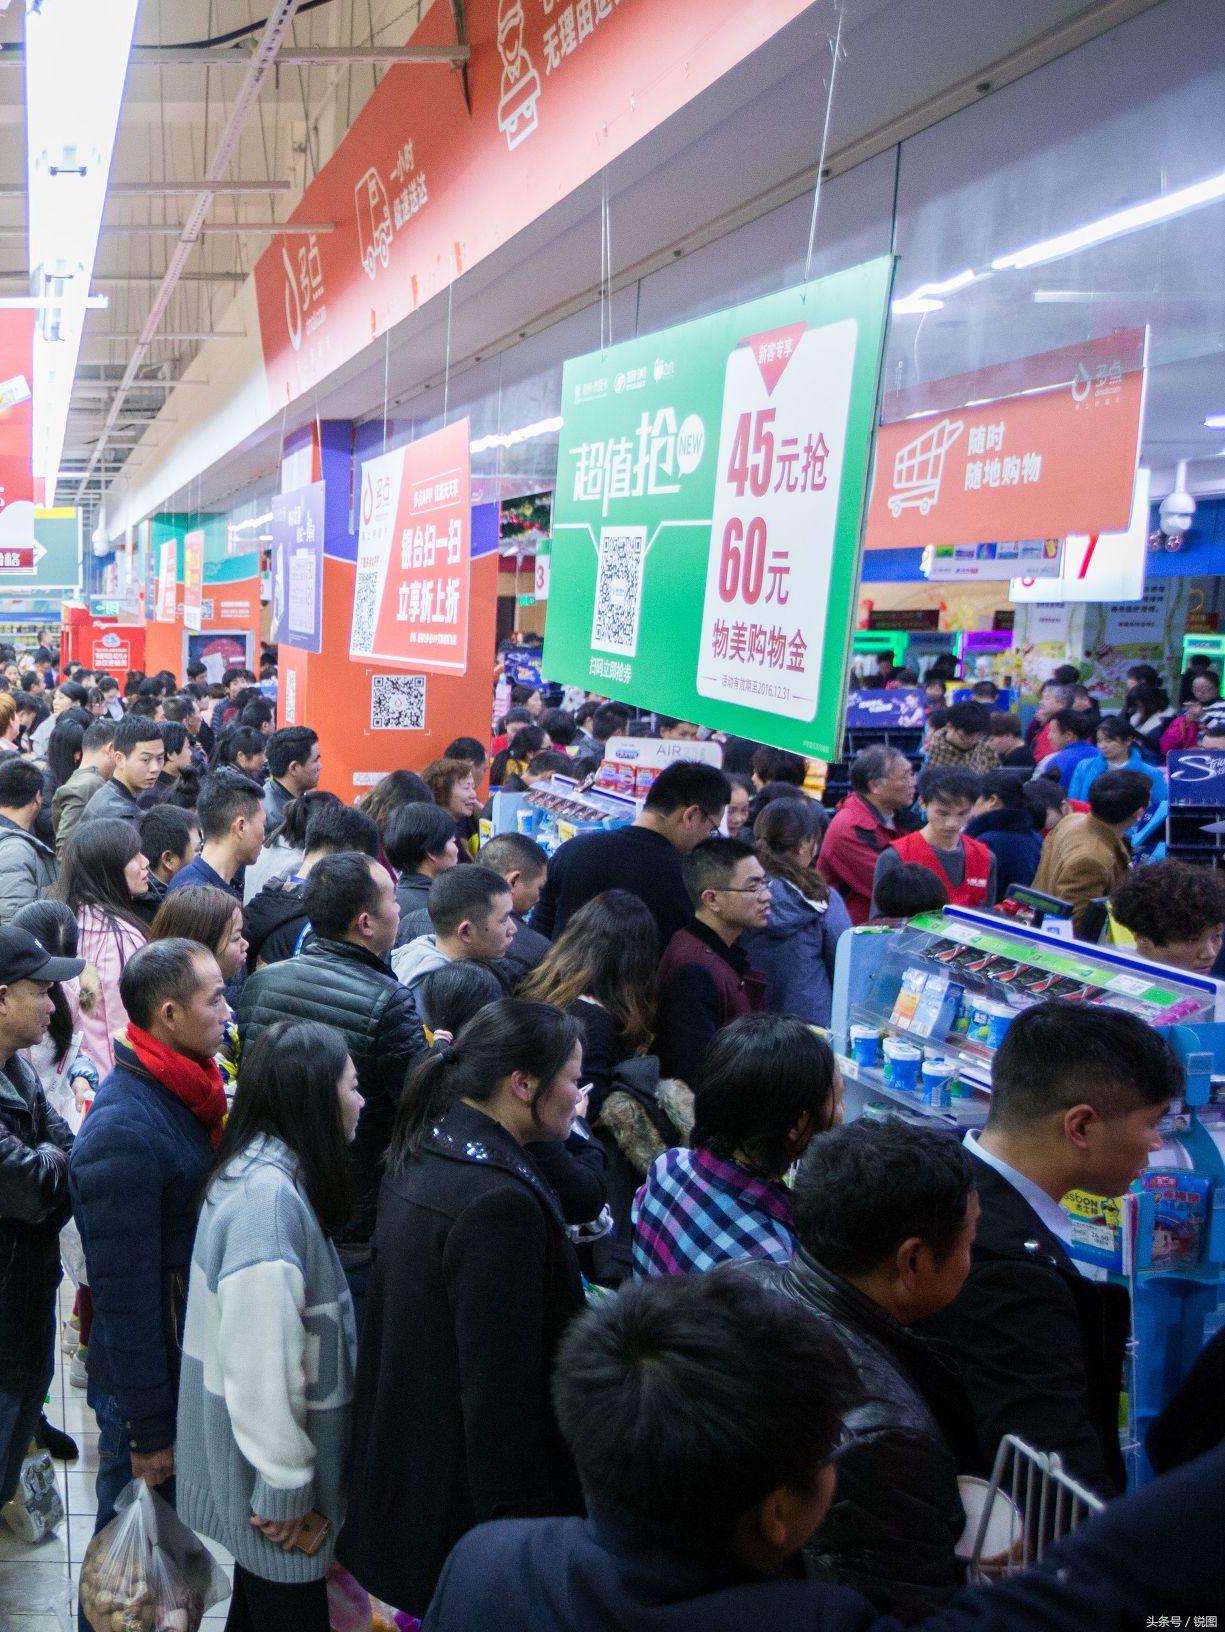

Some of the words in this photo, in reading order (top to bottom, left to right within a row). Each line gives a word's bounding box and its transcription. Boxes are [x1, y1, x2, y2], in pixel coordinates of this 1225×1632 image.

[757, 338, 794, 365] 新客专享
[679, 433, 703, 457] NEW
[727, 408, 829, 498] 45元抢
[967, 421, 1005, 456] 随时
[569, 407, 681, 517] 超值抢
[964, 452, 1042, 492] 随地购物
[401, 519, 462, 569] 银台扫一扫
[718, 516, 790, 605] 60元
[536, 566, 545, 590] 3
[396, 577, 460, 625] 立享折上折
[712, 618, 808, 673] 物美购物金
[656, 743, 682, 757] AIR
